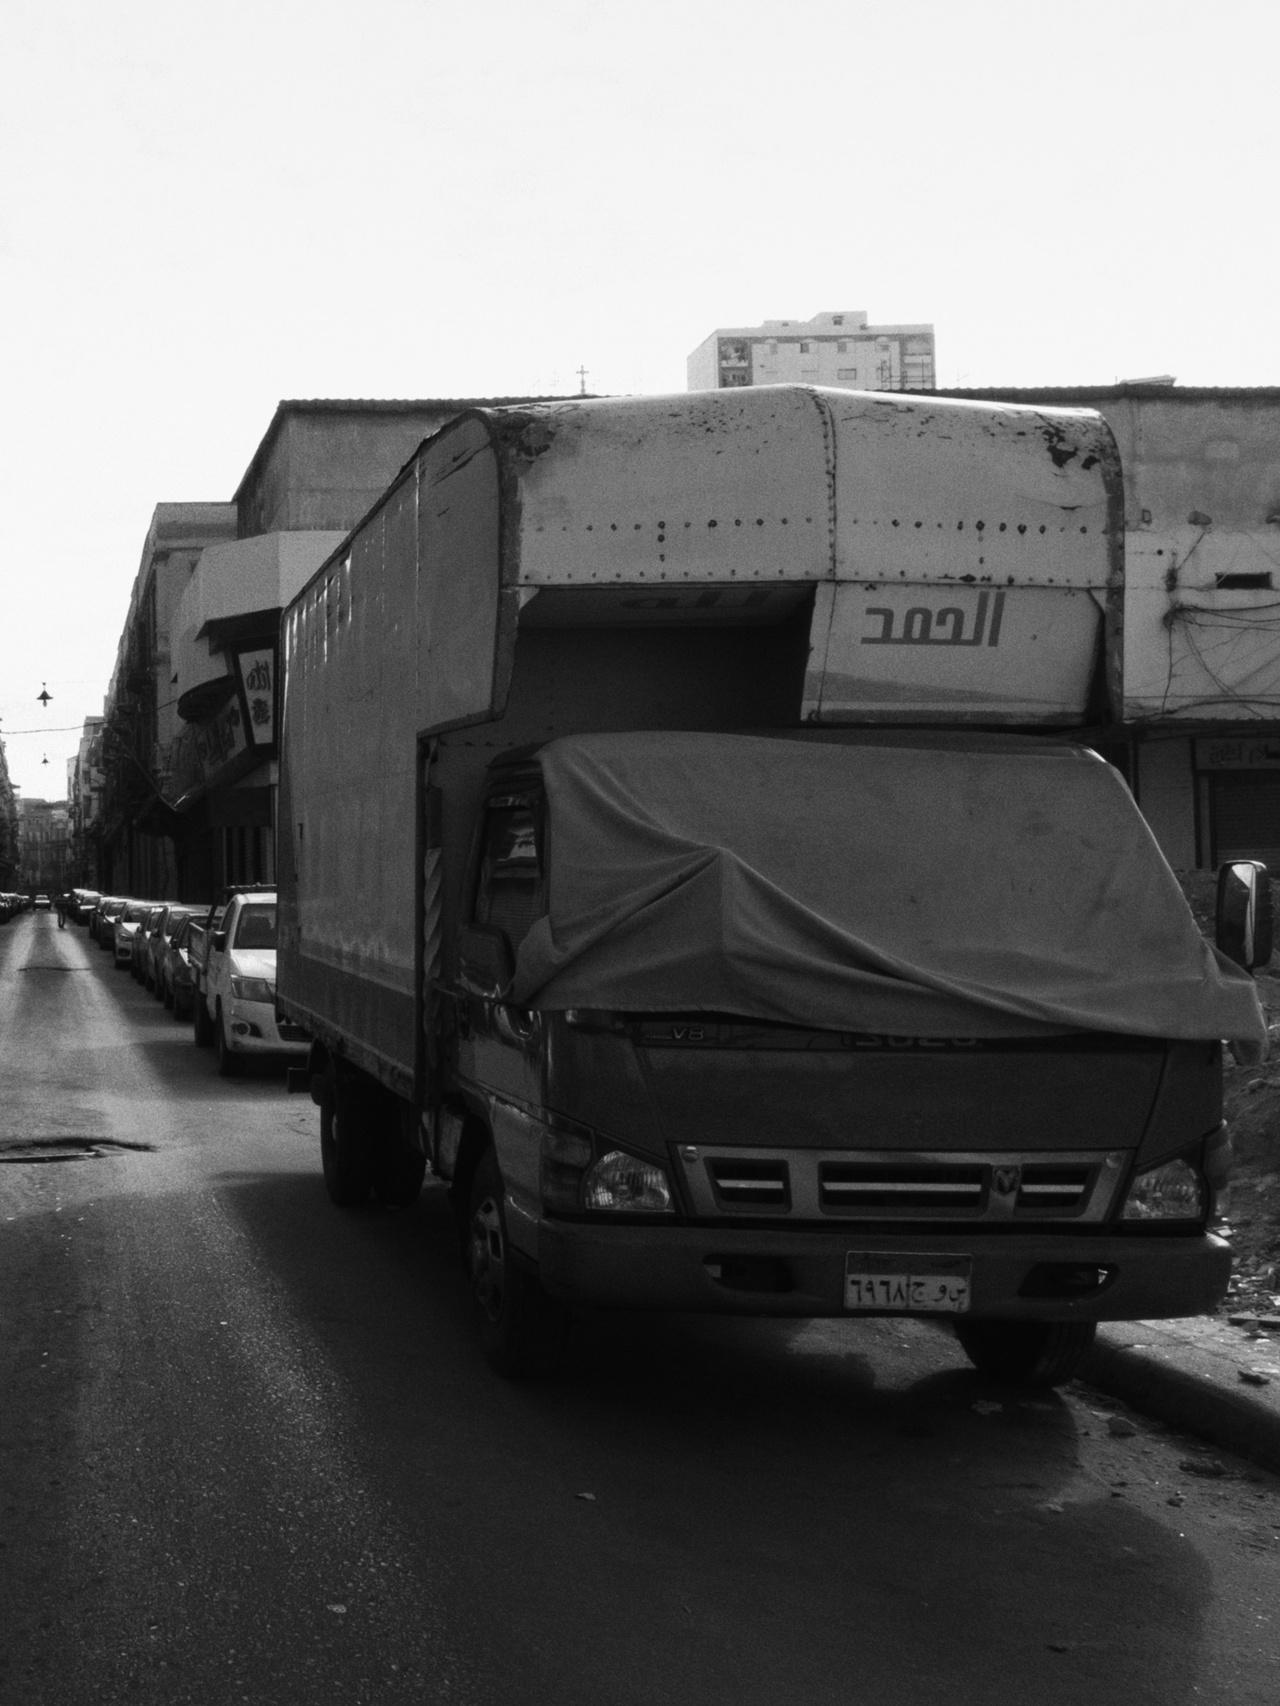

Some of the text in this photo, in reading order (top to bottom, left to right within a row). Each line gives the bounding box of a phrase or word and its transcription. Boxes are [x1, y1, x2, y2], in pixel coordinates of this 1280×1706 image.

[860, 591, 1006, 647] الحمد
[671, 1026, 705, 1041] V8
[850, 1279, 905, 1304] ٦٩٦٨
